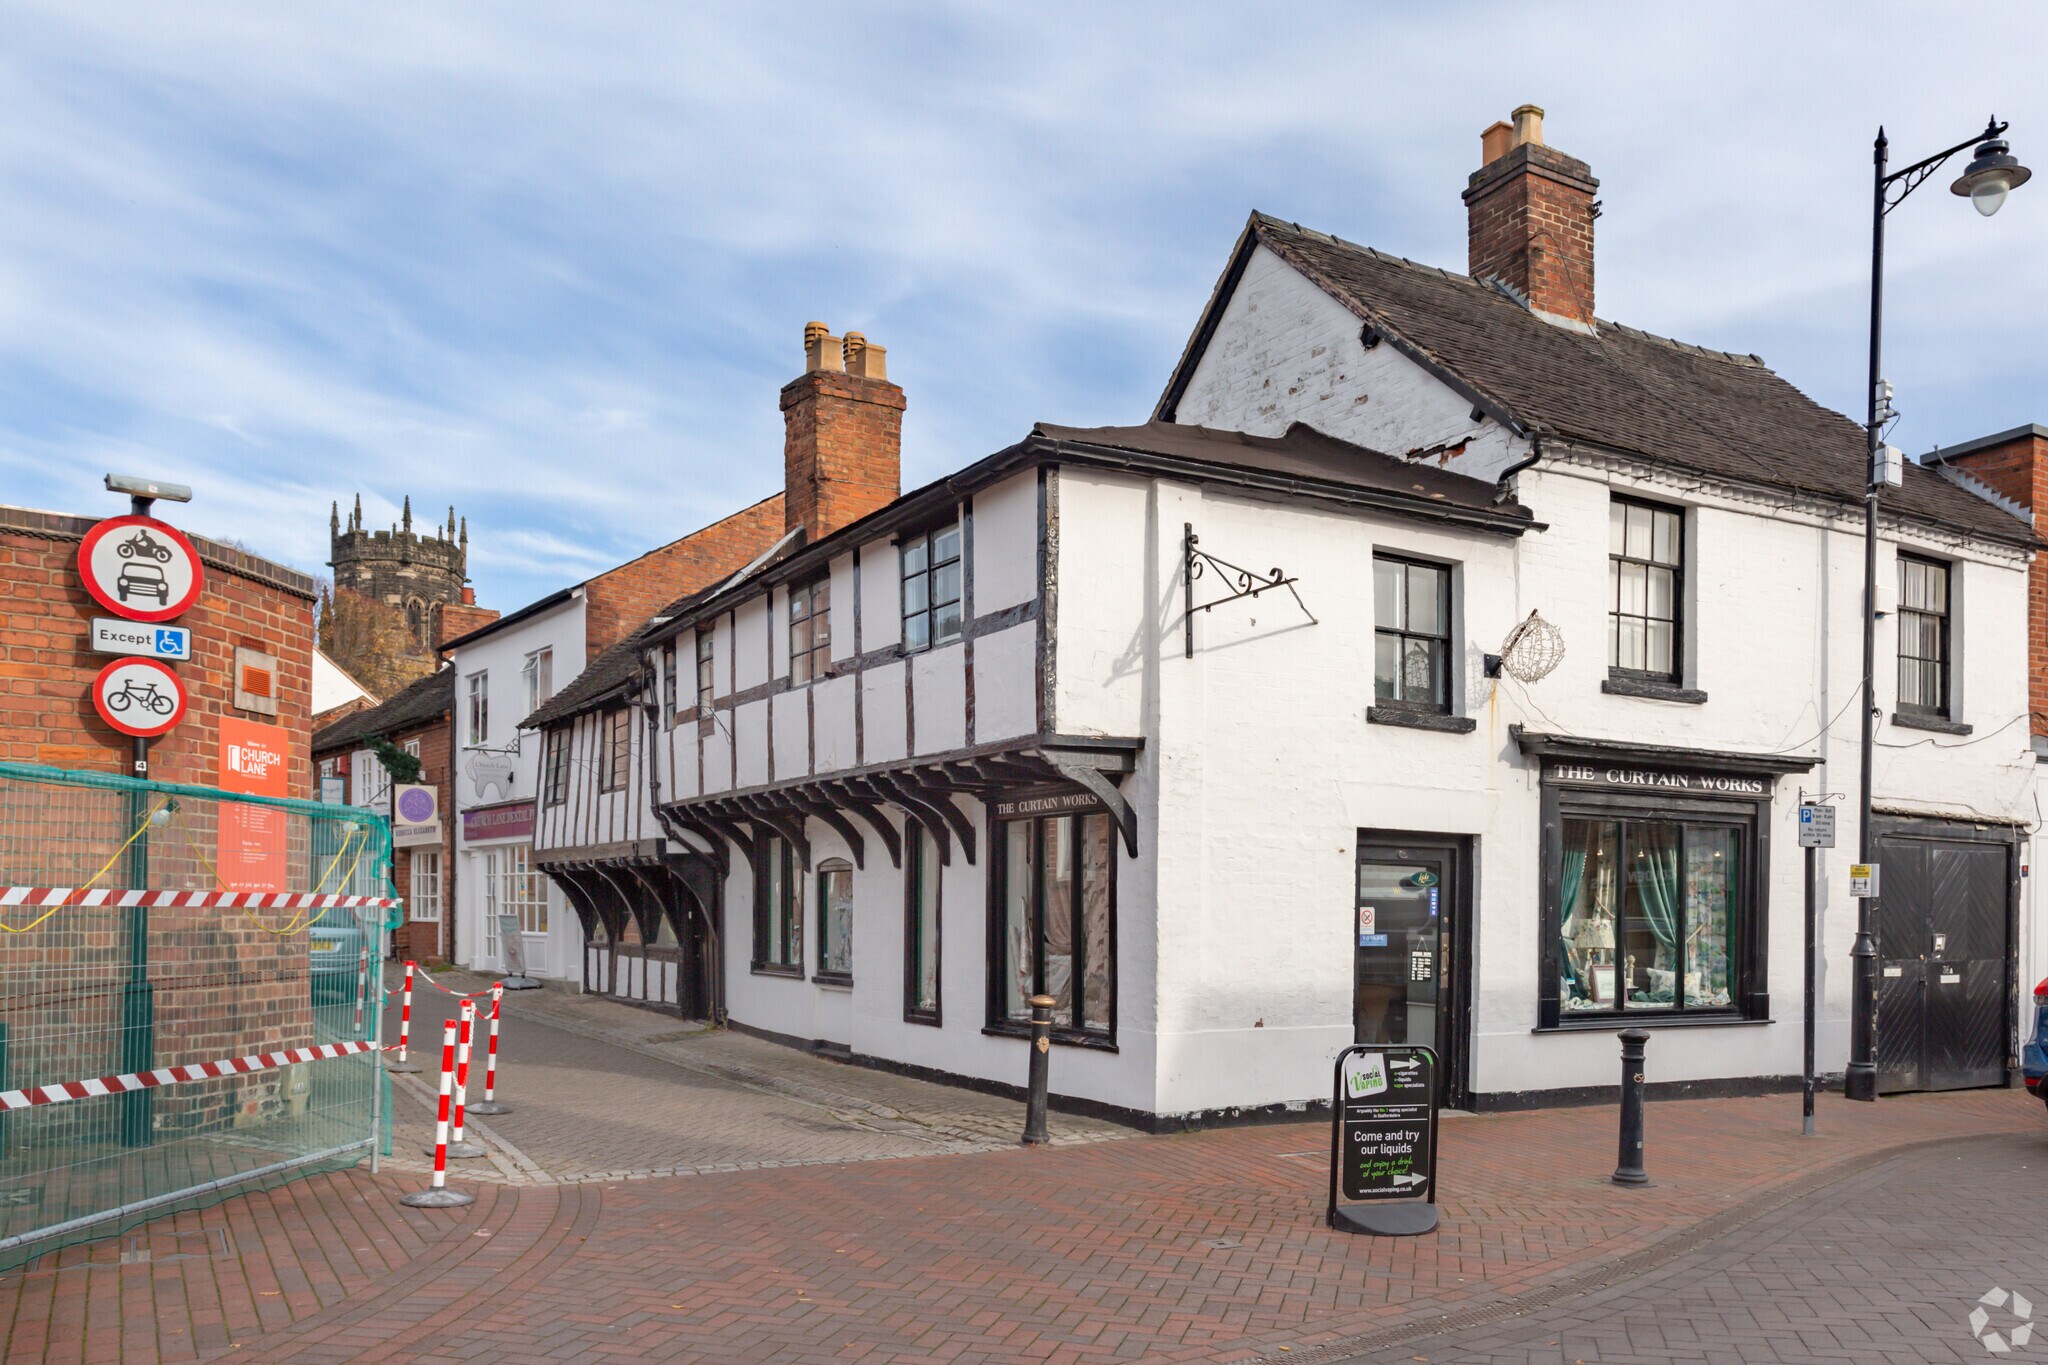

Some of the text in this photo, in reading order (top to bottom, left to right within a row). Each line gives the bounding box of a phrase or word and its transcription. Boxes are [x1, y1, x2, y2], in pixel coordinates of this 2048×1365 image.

[99, 629, 152, 645] Except
[241, 747, 281, 766] CHURCH
[241, 760, 267, 776] LANE
[1554, 764, 1763, 793] THE CURTAIN WORKS
[997, 793, 1098, 814] THE CURTAIN WORKS
[1803, 810, 1810, 822] P
[1362, 1070, 1382, 1081] SOCIAL
[1354, 1130, 1420, 1143] Come and try
[1361, 1143, 1412, 1156] our liquids
[1360, 1159, 1372, 1169] and
[1373, 1160, 1390, 1170] enjoy
[1397, 1155, 1413, 1166] drink
[1362, 1169, 1370, 1177] of
[1371, 1170, 1386, 1180] your
[1359, 1185, 1413, 1194] www.socialvaping.co.uk
